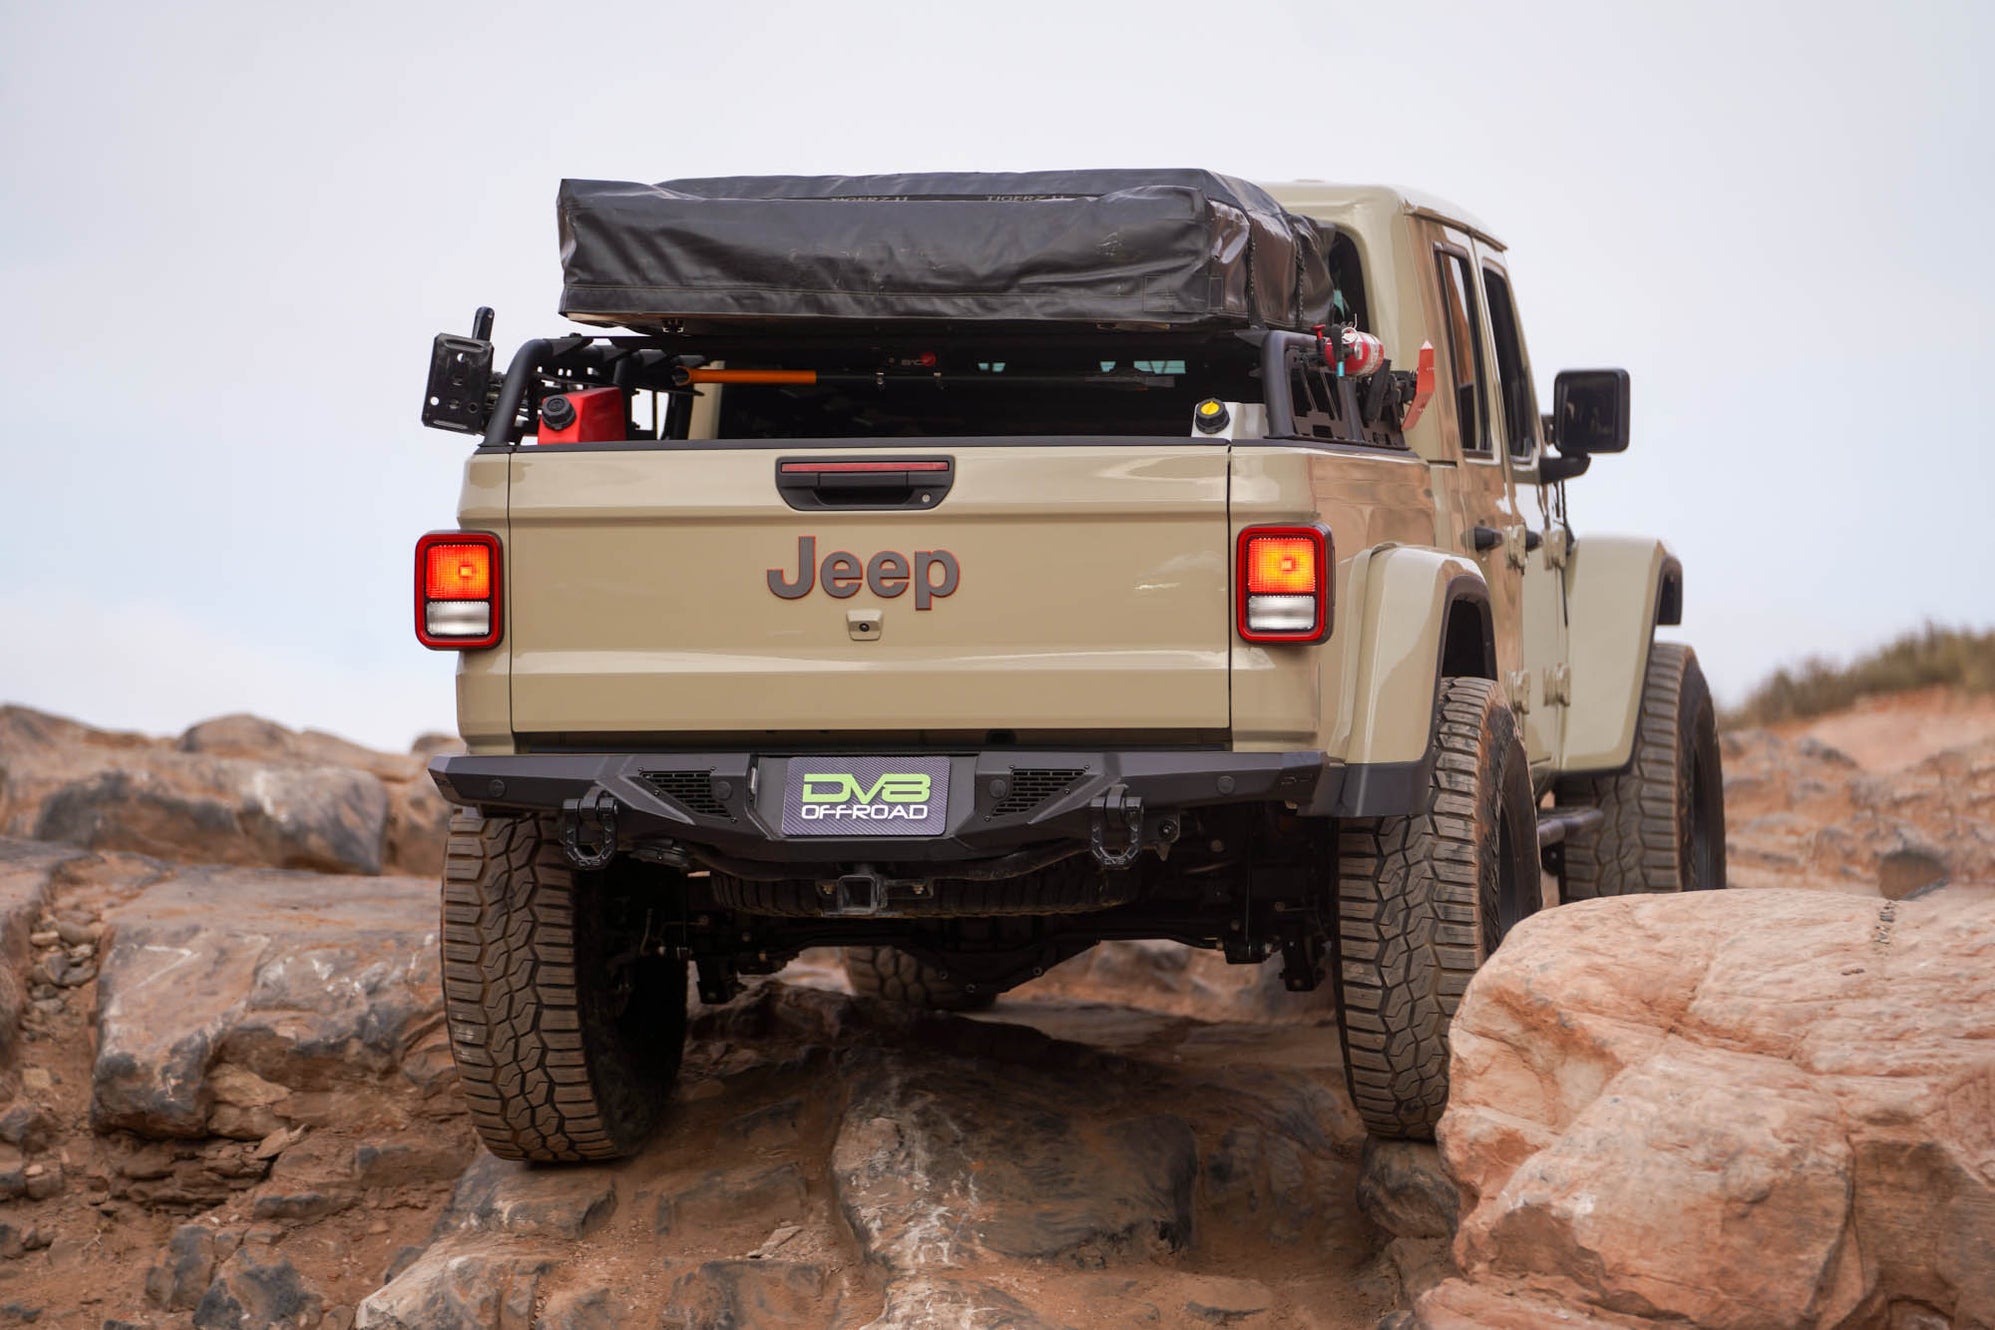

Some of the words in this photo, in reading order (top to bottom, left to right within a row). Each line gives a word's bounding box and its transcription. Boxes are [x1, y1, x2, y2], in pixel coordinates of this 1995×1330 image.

[766, 535, 961, 611] Jeep
[802, 773, 932, 804] DV8
[801, 804, 928, 820] OFFROAD
